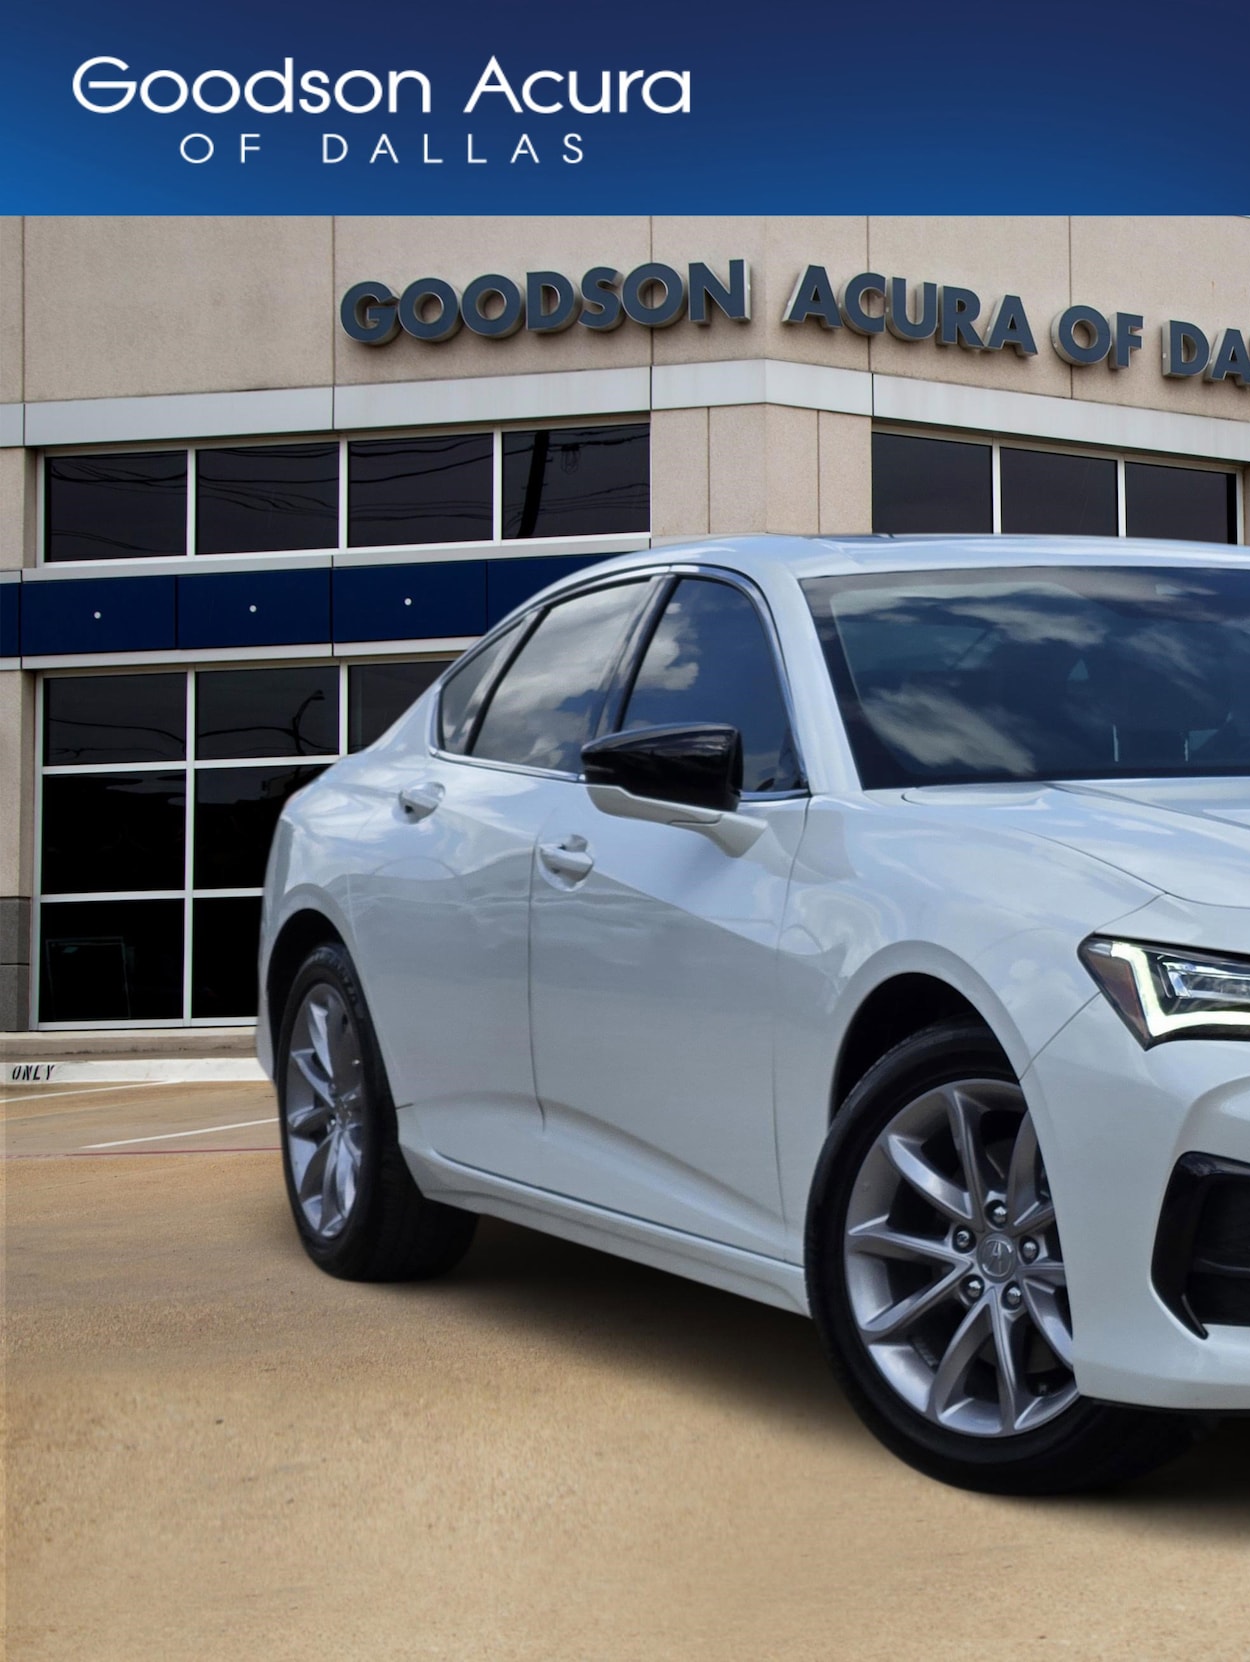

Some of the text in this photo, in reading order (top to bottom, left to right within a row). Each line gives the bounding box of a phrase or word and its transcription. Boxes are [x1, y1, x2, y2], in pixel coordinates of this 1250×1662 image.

[340, 259, 751, 346] GOODSON
[782, 264, 1038, 357] ACURA
[1051, 304, 1144, 369] OF
[12, 1064, 55, 1081] ONLY
